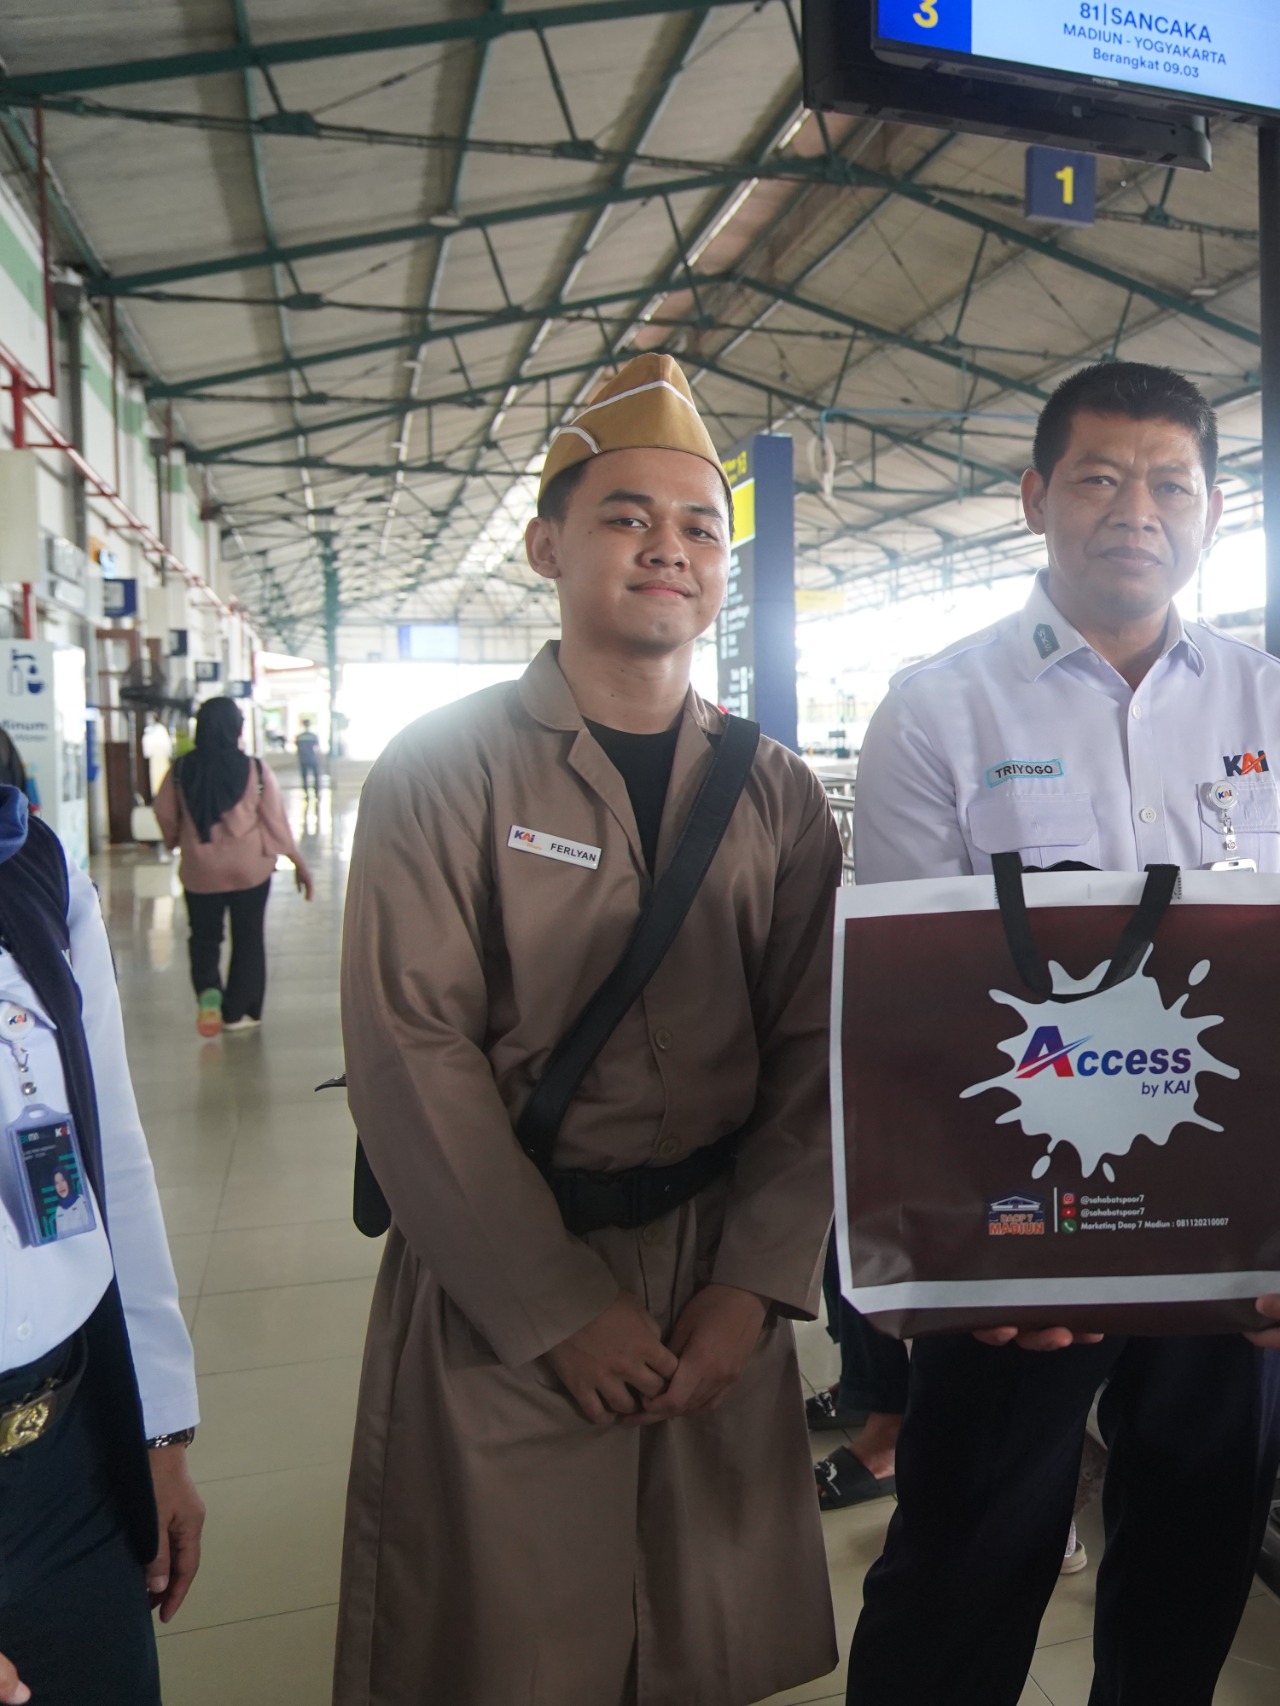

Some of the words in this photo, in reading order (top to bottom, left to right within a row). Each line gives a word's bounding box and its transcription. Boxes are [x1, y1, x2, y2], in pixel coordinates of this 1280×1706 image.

[1063, 23, 1123, 46] MADIUN
[1134, 36, 1228, 66] YOGYAKARTA
[1093, 47, 1160, 70] Berangkat
[1163, 61, 1200, 78] 09.03
[1055, 166, 1074, 205] 1
[994, 763, 1054, 780] TRIYOGO
[1222, 750, 1270, 777] KAI
[550, 843, 597, 862] FERLYAN
[1014, 1025, 1192, 1080] Access
[1141, 1082, 1160, 1098] by
[1163, 1080, 1191, 1095] KAI
[989, 1222, 1045, 1236] MADIUN
[1081, 1221, 1117, 1232] Marketing
[1118, 1220, 1137, 1231] Daop
[1144, 1220, 1171, 1229] Madiun
